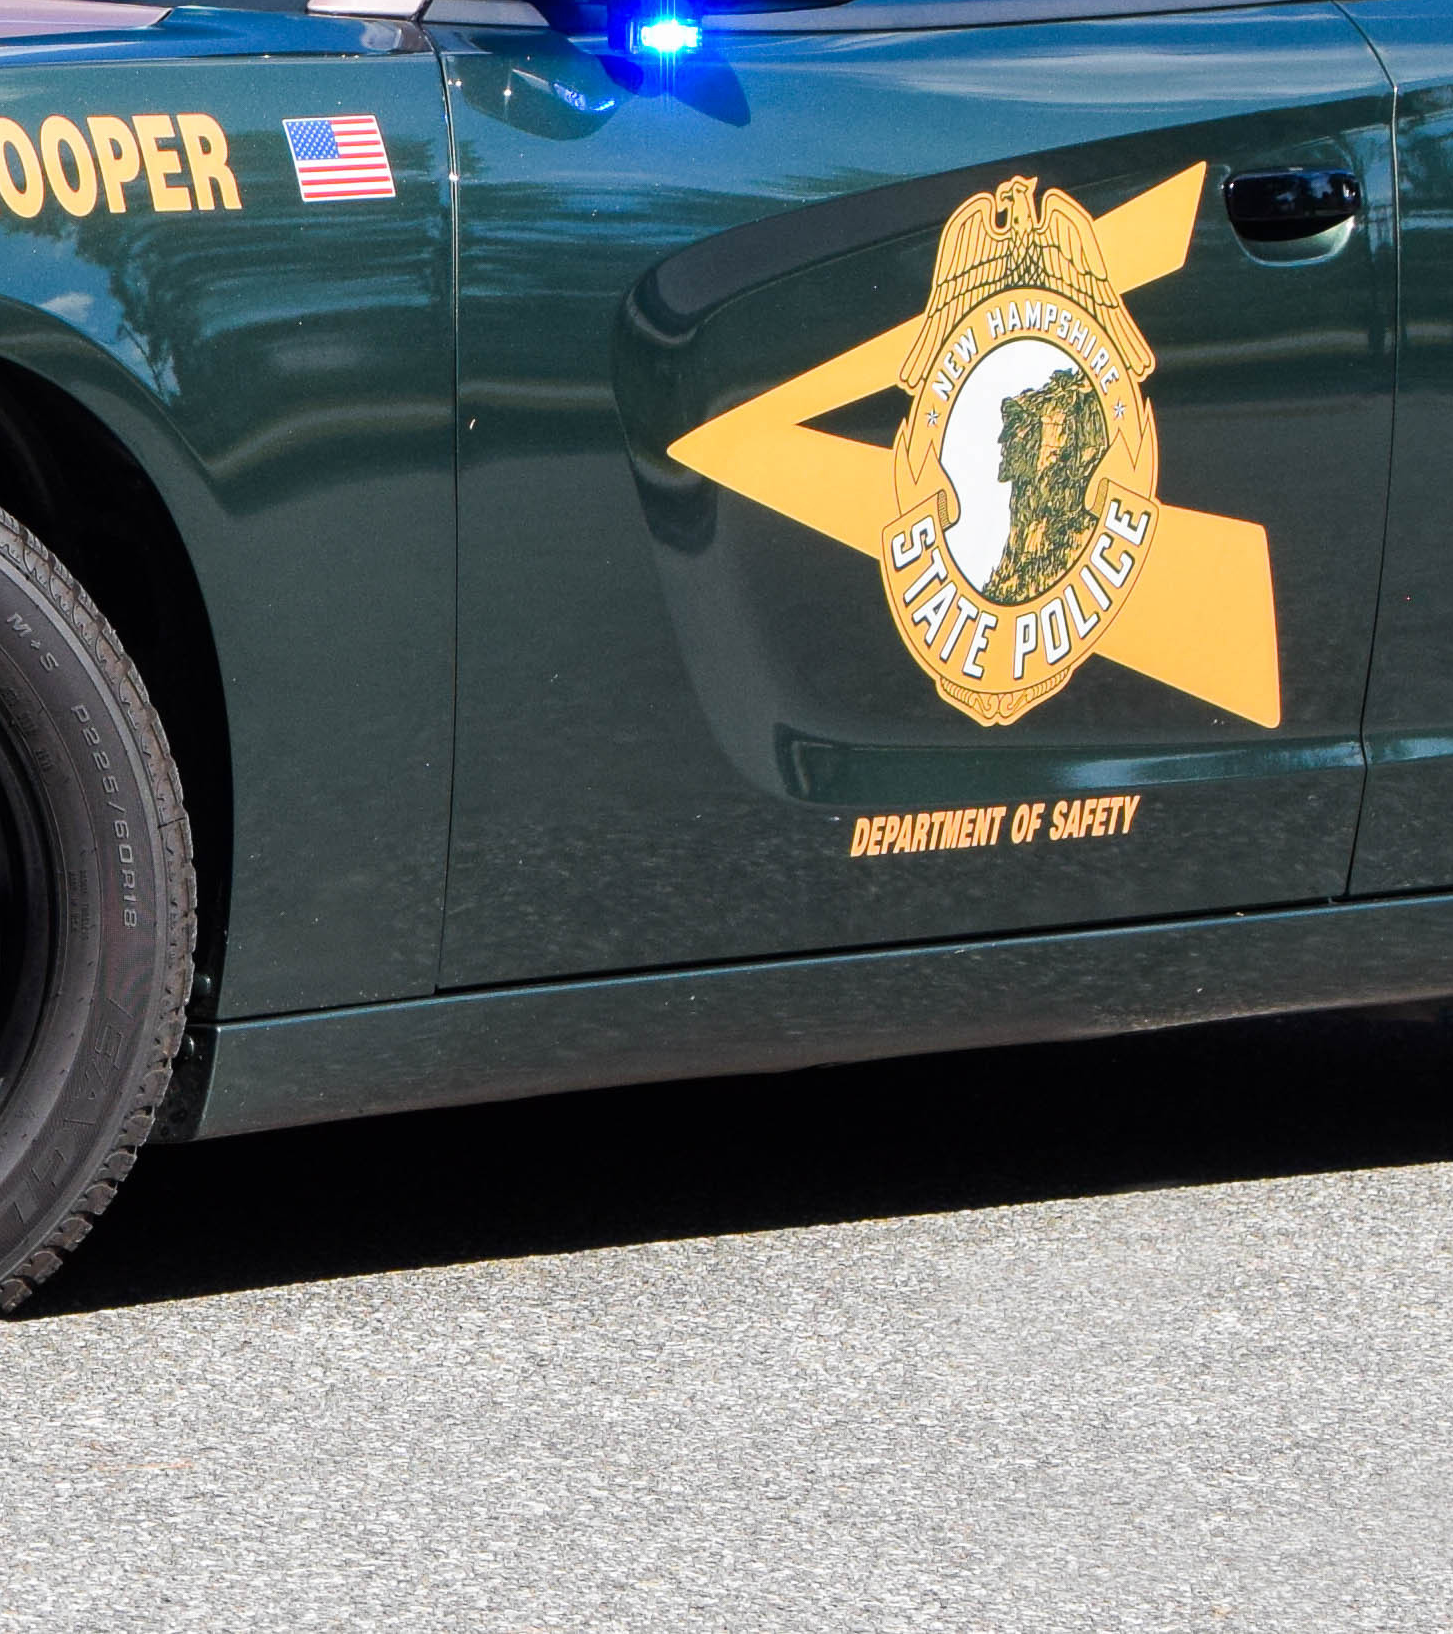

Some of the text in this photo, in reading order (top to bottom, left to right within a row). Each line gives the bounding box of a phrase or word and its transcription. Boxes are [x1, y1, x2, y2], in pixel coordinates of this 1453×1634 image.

[931, 300, 1120, 402] NEW HAMPSHIRE
[891, 498, 1151, 680] STATE POLICE
[71, 703, 137, 928] P225/60R18
[850, 795, 1141, 857] DEPARTMENT OF SAFETY
